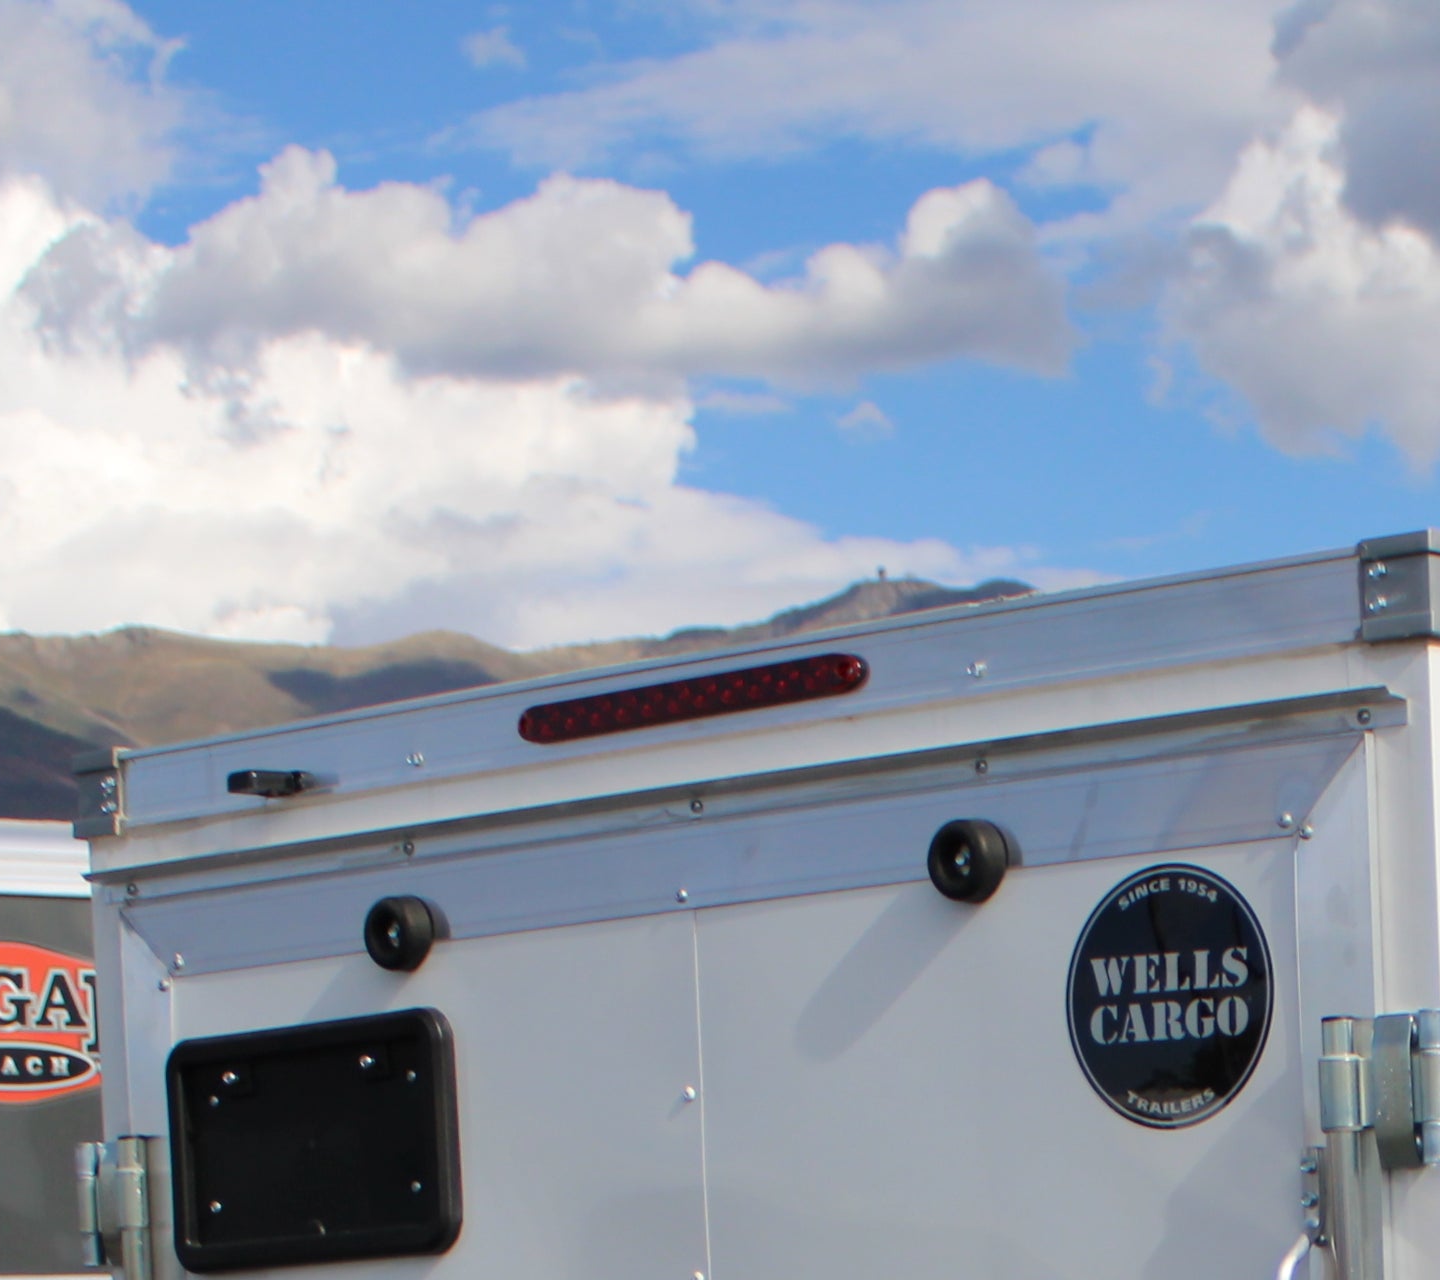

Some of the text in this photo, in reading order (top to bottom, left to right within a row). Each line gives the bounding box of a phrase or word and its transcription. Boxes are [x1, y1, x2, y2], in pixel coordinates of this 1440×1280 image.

[1117, 878, 1218, 911] SINCE 1954
[1090, 947, 1249, 997] WELLS
[1090, 996, 1250, 1046] CARGO
[1126, 1087, 1216, 1115] TRAILERS
